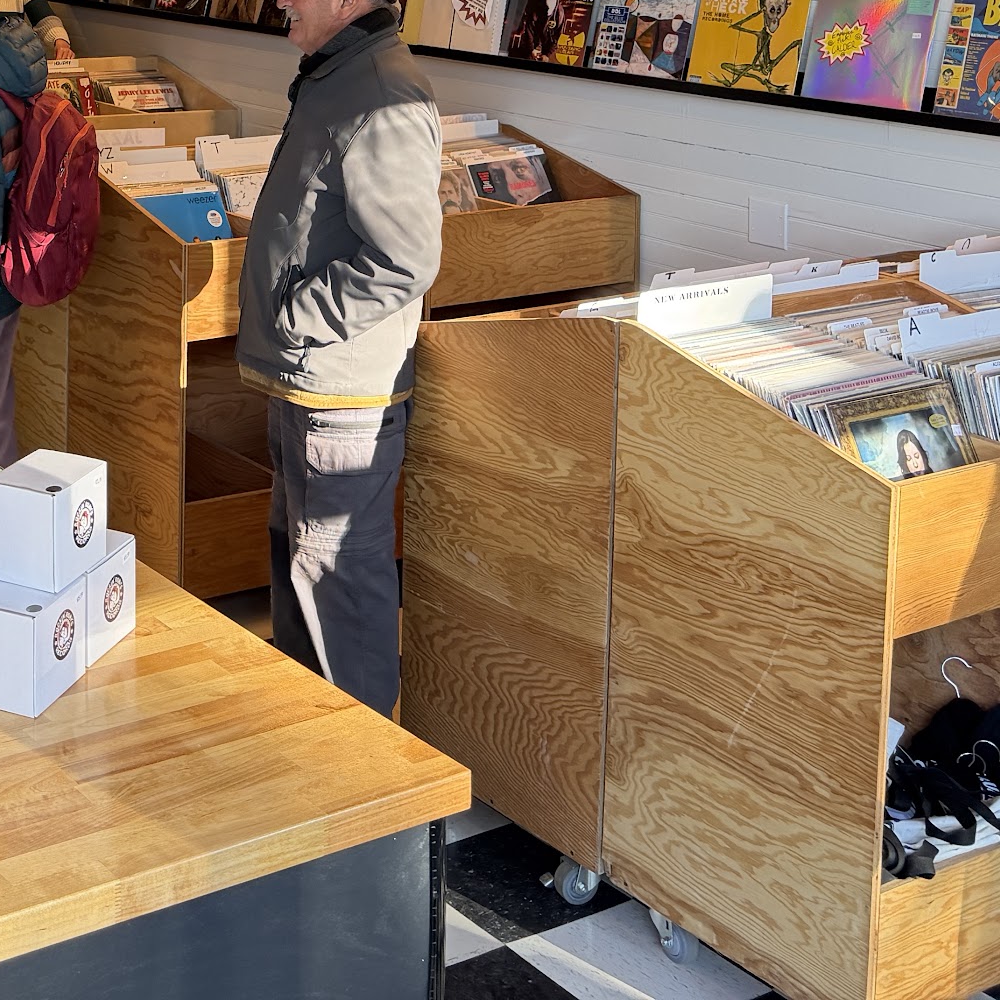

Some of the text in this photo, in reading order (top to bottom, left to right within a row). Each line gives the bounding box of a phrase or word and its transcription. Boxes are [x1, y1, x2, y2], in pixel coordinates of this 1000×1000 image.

[711, 1, 749, 15] HECK
[210, 141, 221, 154] T
[100, 163, 114, 175] W
[186, 193, 218, 205] weezer
[664, 271, 676, 280] T
[654, 286, 730, 304] NEW ARRIVALS
[909, 317, 922, 336] A
